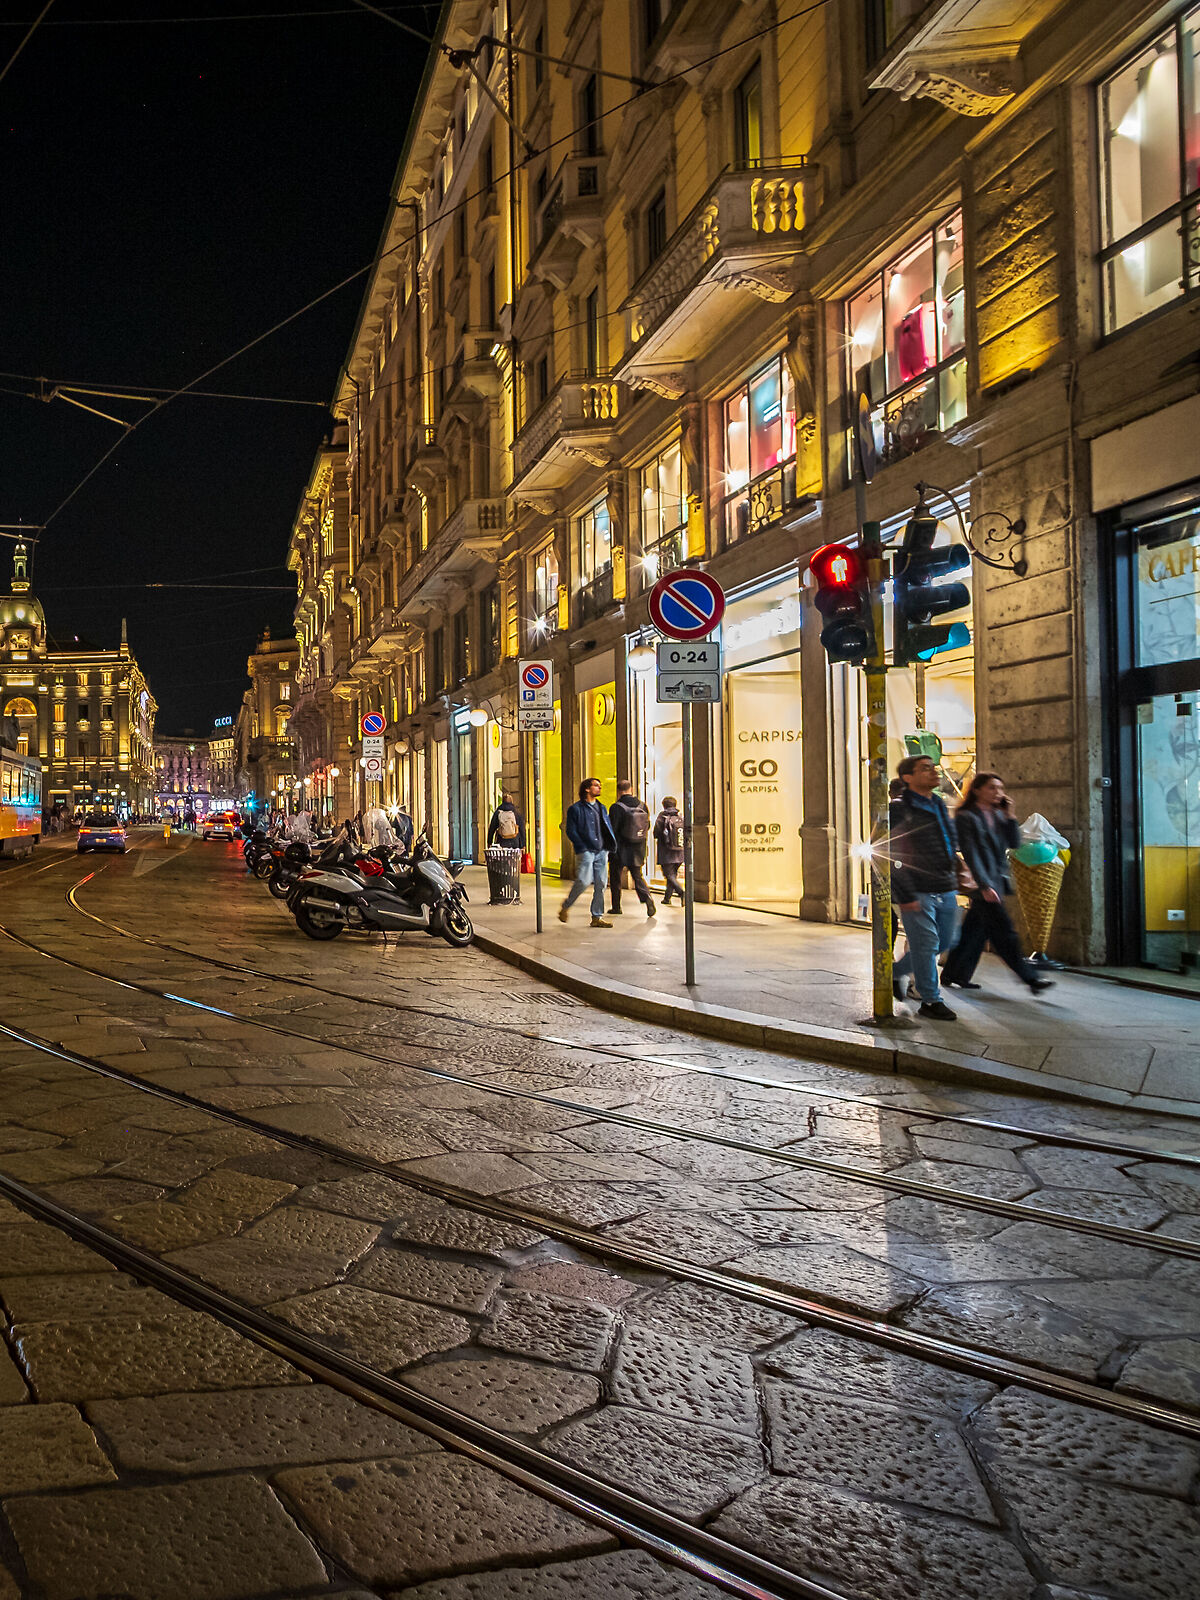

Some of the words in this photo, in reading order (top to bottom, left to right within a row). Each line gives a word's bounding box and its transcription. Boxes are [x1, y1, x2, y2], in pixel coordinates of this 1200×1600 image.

[670, 651, 708, 663] 0-24
[214, 716, 232, 727] GUCCI
[738, 730, 803, 742] CARPISA
[739, 759, 778, 777] GO
[739, 785, 779, 793] CARPISA
